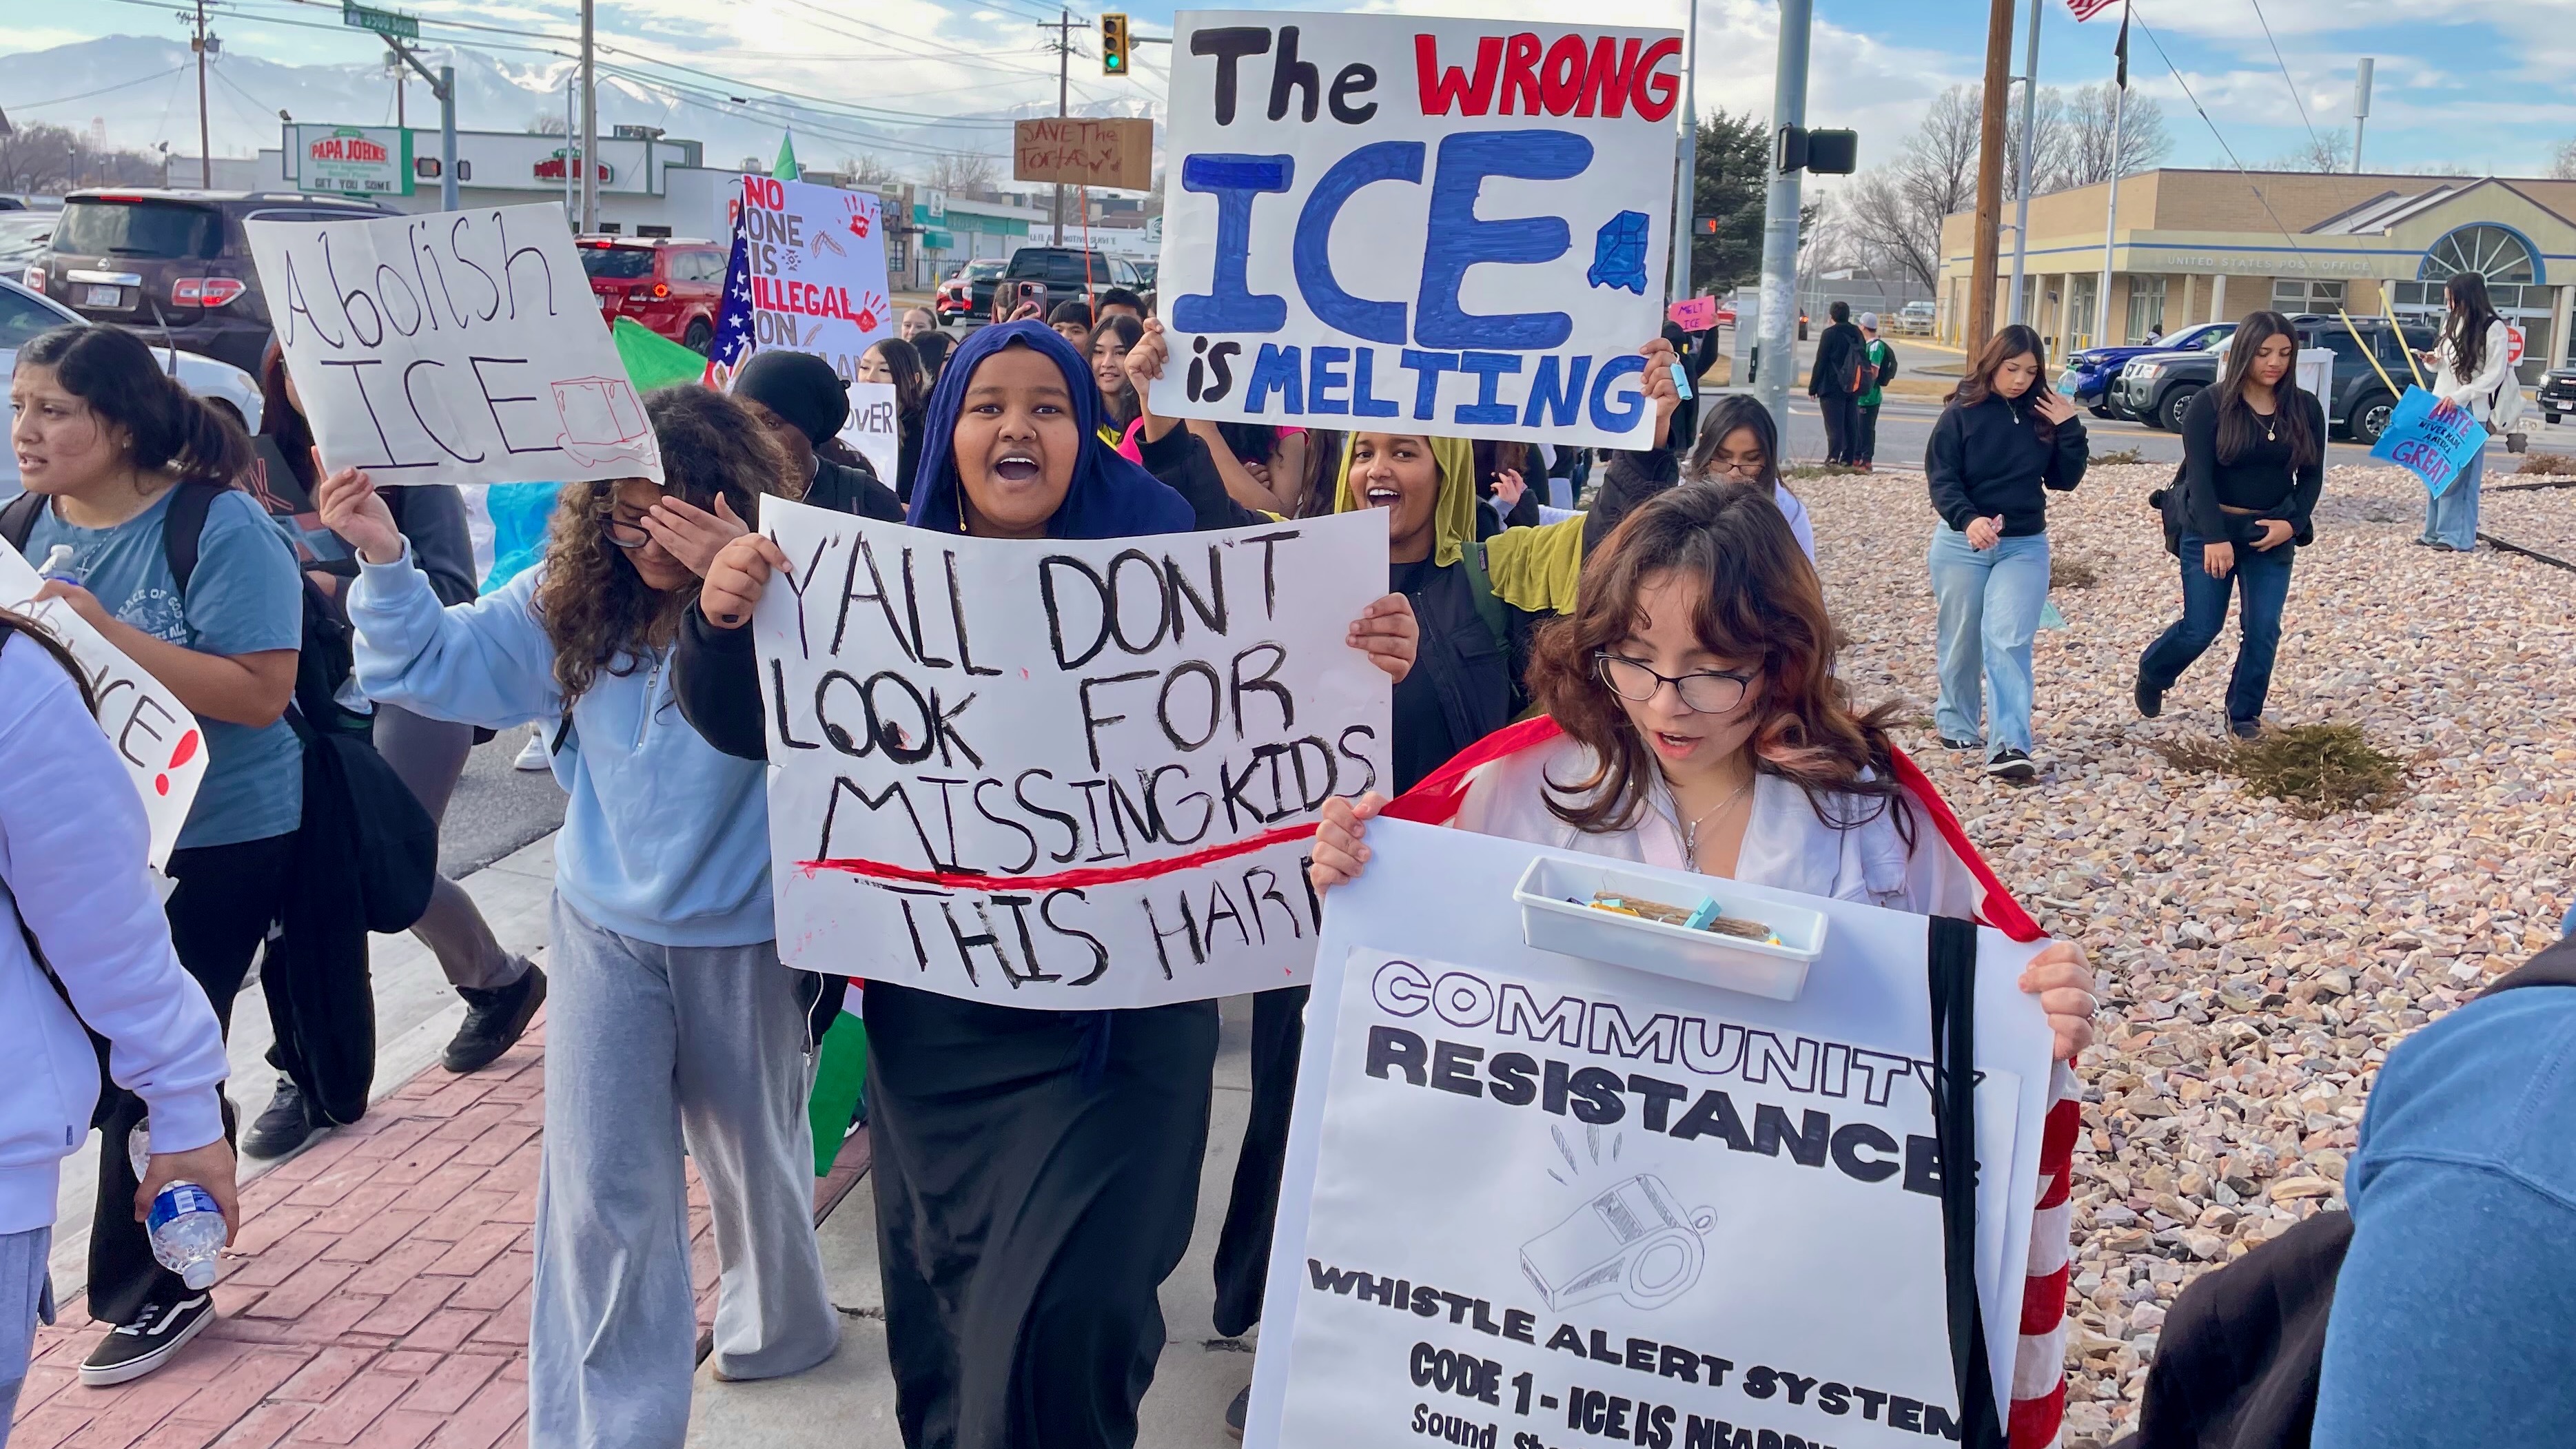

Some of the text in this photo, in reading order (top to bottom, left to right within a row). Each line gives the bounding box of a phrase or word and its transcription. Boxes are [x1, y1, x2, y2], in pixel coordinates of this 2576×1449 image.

[1190, 25, 1683, 125] The WRONG
[311, 139, 343, 158] PAPA
[1019, 120, 1075, 143] SAVE
[744, 175, 784, 212] NO
[746, 207, 804, 248] ONE
[1172, 130, 1595, 350] ICE
[283, 212, 558, 349] Abolish
[750, 242, 778, 276] IS
[2168, 256, 2371, 271] UNITED STATES POST OFFICE
[753, 276, 859, 321] ILLEGAL
[1677, 303, 1704, 316] MELT
[756, 309, 798, 347] ON
[1684, 318, 1700, 329] ICE
[1186, 336, 1650, 433] is MELTING
[320, 356, 564, 470] ICE
[115, 588, 183, 621] PEACE OF GOD
[770, 639, 1296, 773] LOOK FOR
[852, 875, 1109, 989] THIS
[1365, 1025, 1981, 1199] RESISTANCE
[1307, 1258, 1535, 1346] WHISTLE
[1545, 1324, 1734, 1386] ALERT
[1410, 1342, 1503, 1407] CODE
[1511, 1371, 1534, 1417] 1
[1568, 1386, 1632, 1441] ICE
[1635, 1401, 1677, 1449] IS
[1411, 1403, 1497, 1449] Sound
